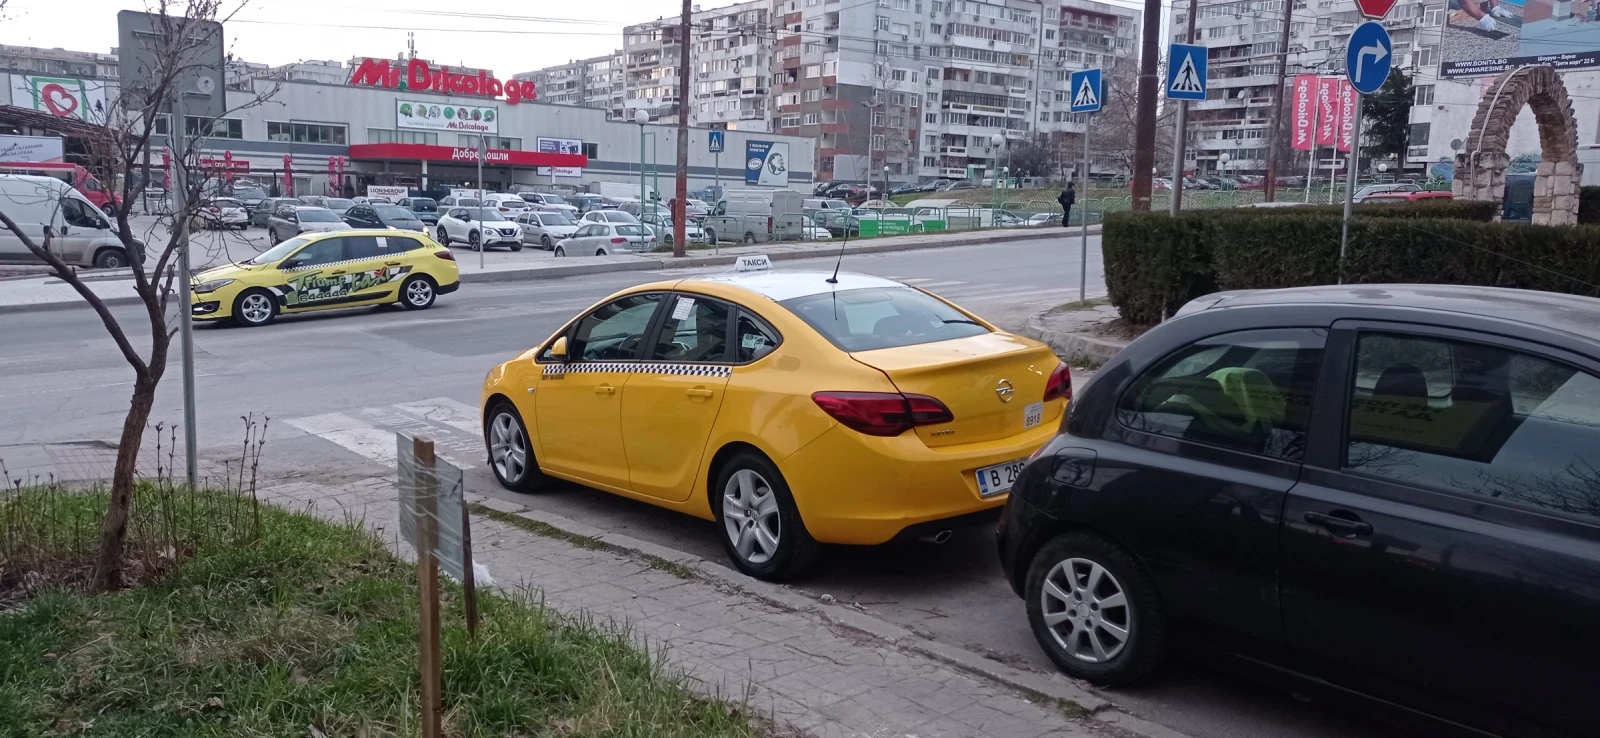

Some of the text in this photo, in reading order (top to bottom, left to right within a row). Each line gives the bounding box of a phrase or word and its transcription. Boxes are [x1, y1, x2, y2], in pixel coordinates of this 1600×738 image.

[1455, 59, 1508, 68] WWW.BONITA.BG
[349, 57, 537, 105] Mr. Bricolage
[459, 121, 489, 132] Bricolage
[451, 148, 479, 161] Добре
[742, 258, 768, 267] ТАКСИ
[299, 289, 348, 303] 644444
[1025, 413, 1041, 427] 8918
[990, 469, 1001, 487] B
